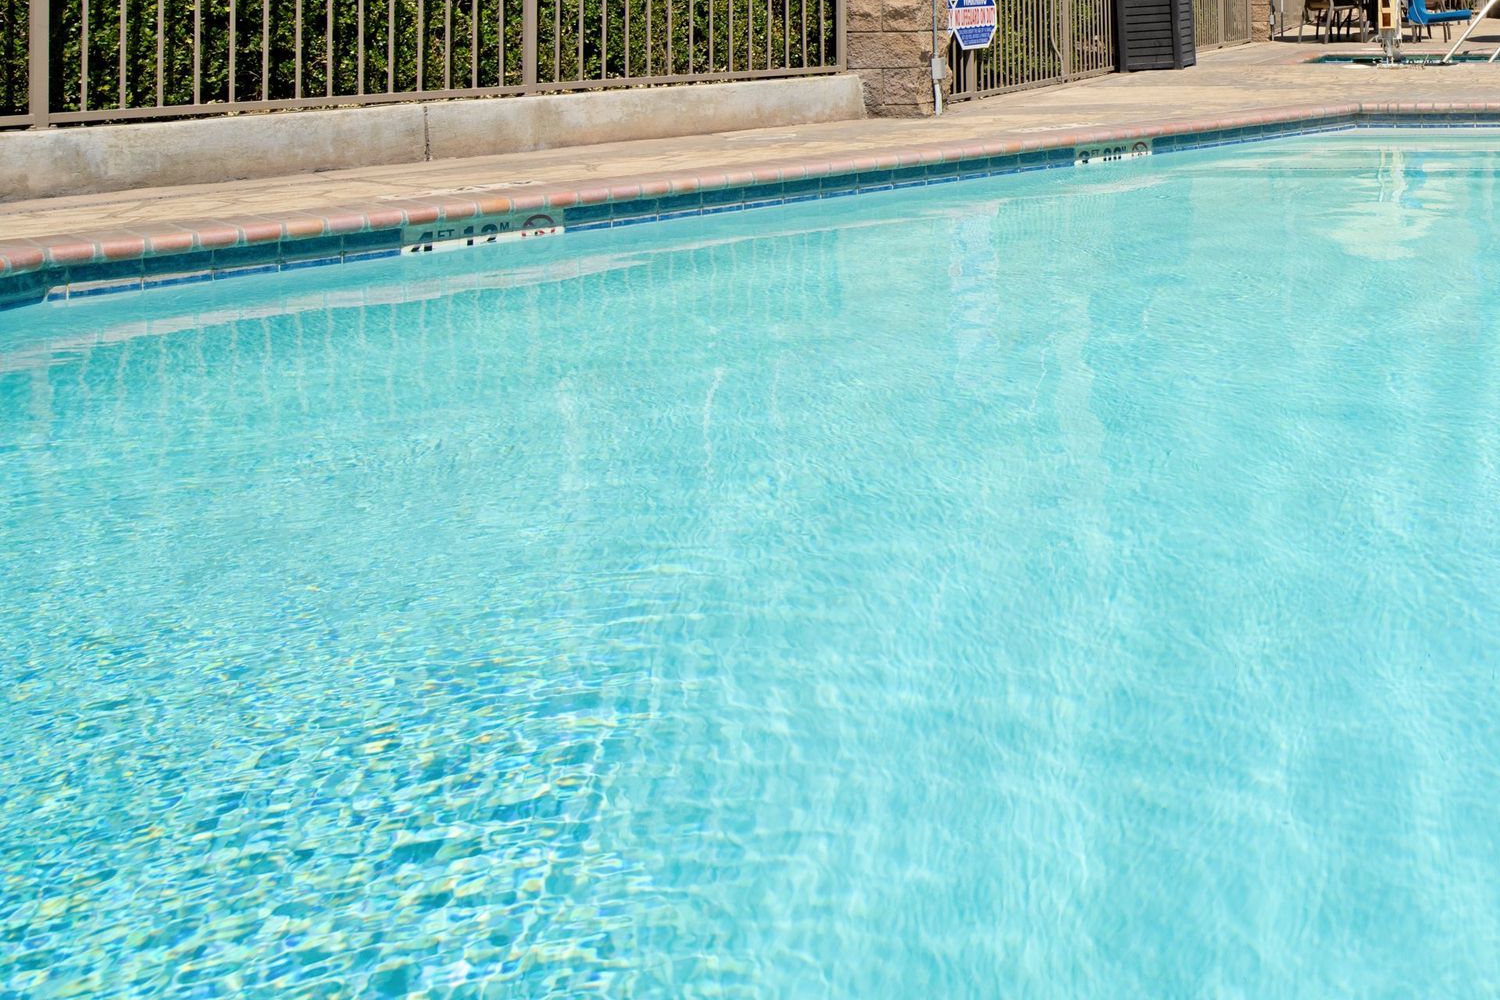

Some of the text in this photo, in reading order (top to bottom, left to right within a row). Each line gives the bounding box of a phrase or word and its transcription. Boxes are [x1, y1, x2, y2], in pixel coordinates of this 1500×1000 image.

[961, 8, 979, 26] LIFEGUARD
[986, 7, 995, 24] DUTY
[437, 229, 454, 239] FT
[499, 221, 510, 230] M
